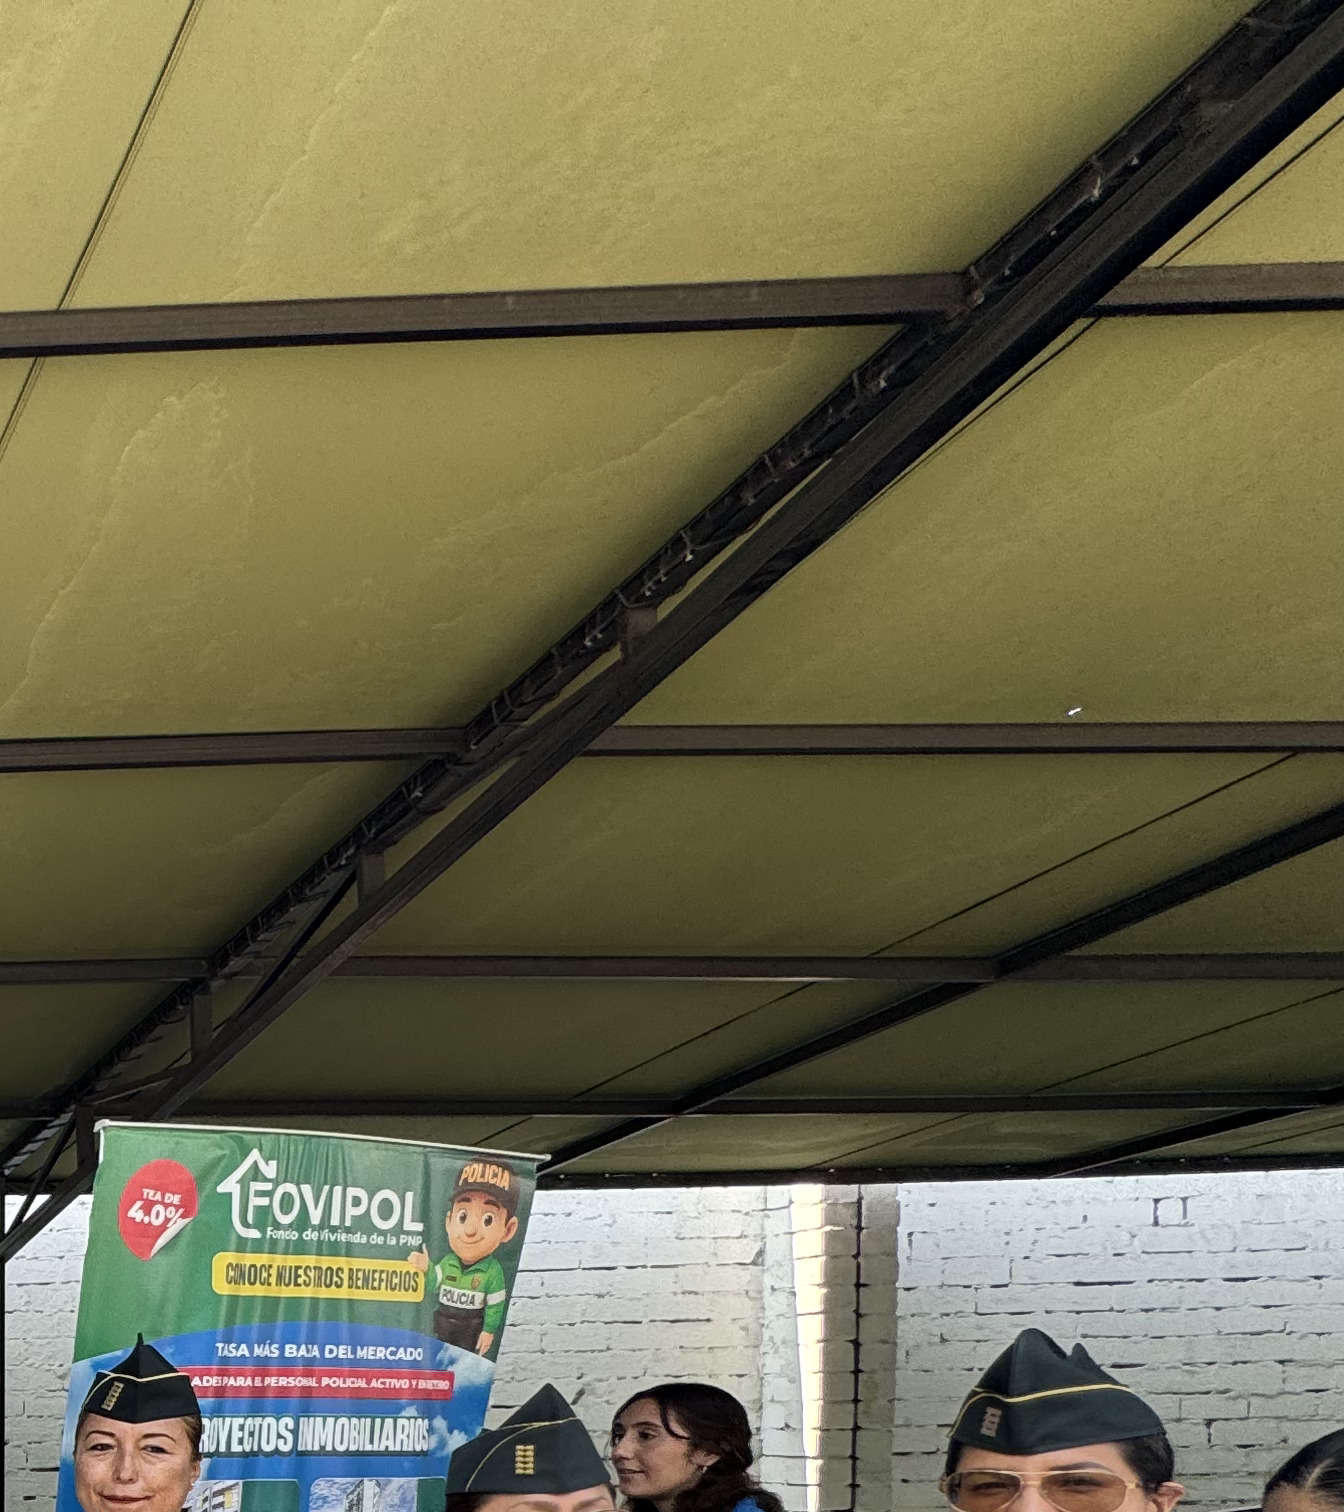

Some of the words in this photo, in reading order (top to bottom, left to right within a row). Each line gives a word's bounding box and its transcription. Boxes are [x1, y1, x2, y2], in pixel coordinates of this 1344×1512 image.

[458, 1161, 510, 1191] POLICIA
[142, 1188, 161, 1202] TEA
[163, 1191, 181, 1205] DE
[247, 1182, 424, 1232] FOVIPOL
[127, 1201, 186, 1228] 4.0%
[266, 1226, 298, 1241] Fondo
[302, 1228, 319, 1241] de
[320, 1229, 367, 1245] Vivienda
[369, 1232, 384, 1245] de
[387, 1233, 397, 1246] la
[399, 1234, 422, 1248] PNP
[225, 1261, 272, 1287] CONOCE
[275, 1262, 343, 1289] NUESTROS
[348, 1266, 419, 1293] BENEFICIOS
[441, 1288, 475, 1307] POLICIA
[216, 1342, 249, 1358] TASA
[253, 1340, 279, 1358] MÁS
[284, 1344, 320, 1359] BAJA
[324, 1344, 354, 1359] DEL
[356, 1346, 423, 1361] MERCADO
[222, 1377, 252, 1387] PARA
[370, 1378, 409, 1389] ACTIVO
[411, 1379, 417, 1389] Y
[199, 1415, 294, 1453] ROYECTOS
[297, 1416, 429, 1452] INMOBILIARIOS
